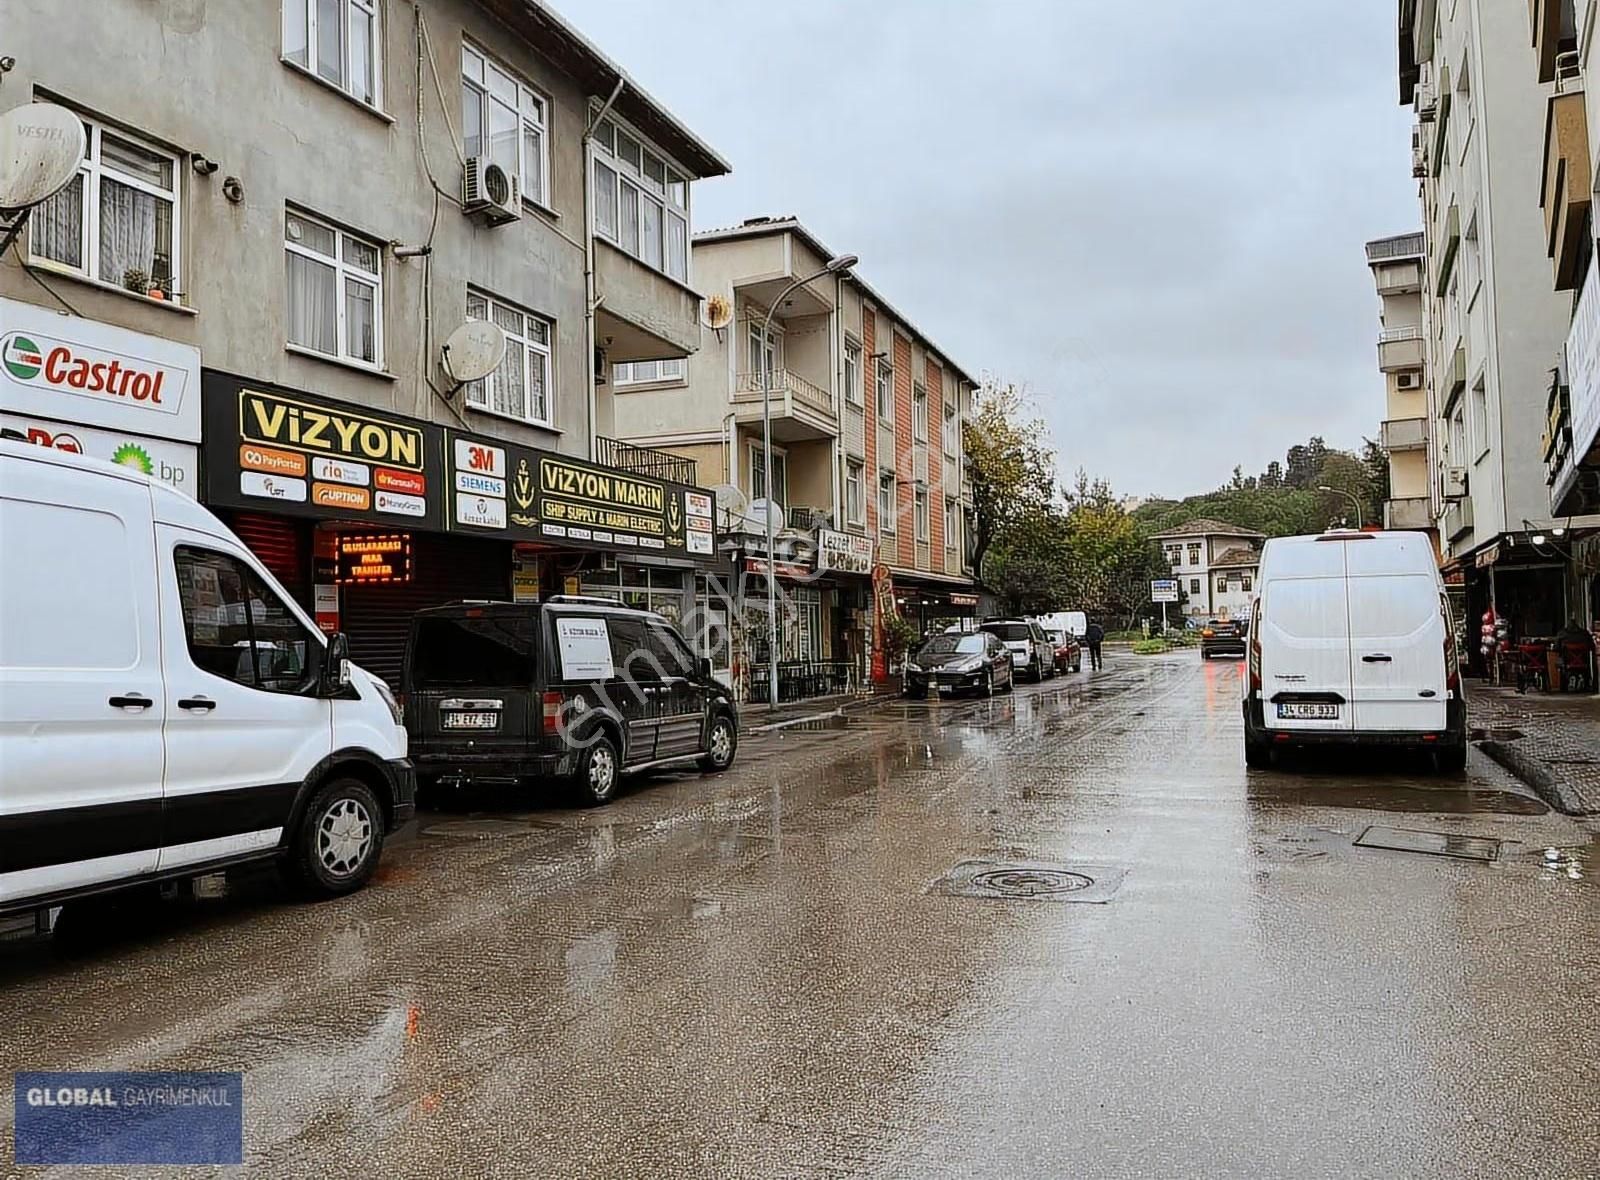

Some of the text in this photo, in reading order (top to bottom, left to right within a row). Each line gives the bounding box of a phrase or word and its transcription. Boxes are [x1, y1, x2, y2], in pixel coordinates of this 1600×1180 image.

[45, 346, 163, 404] Castrol
[262, 455, 303, 470] PayPorter
[468, 446, 494, 472] 3M
[160, 461, 185, 486] bp
[323, 461, 343, 479] ria
[460, 478, 502, 494] SIEMENS
[329, 491, 364, 504] UPTION
[387, 499, 423, 512] MoneyGram
[545, 503, 567, 517] SHIP
[567, 506, 598, 523] SUPPLY
[599, 512, 605, 524] &
[823, 531, 849, 552] Lezzet
[352, 565, 392, 576] TRANSFER
[1284, 706, 1336, 715] 34 CRG 933
